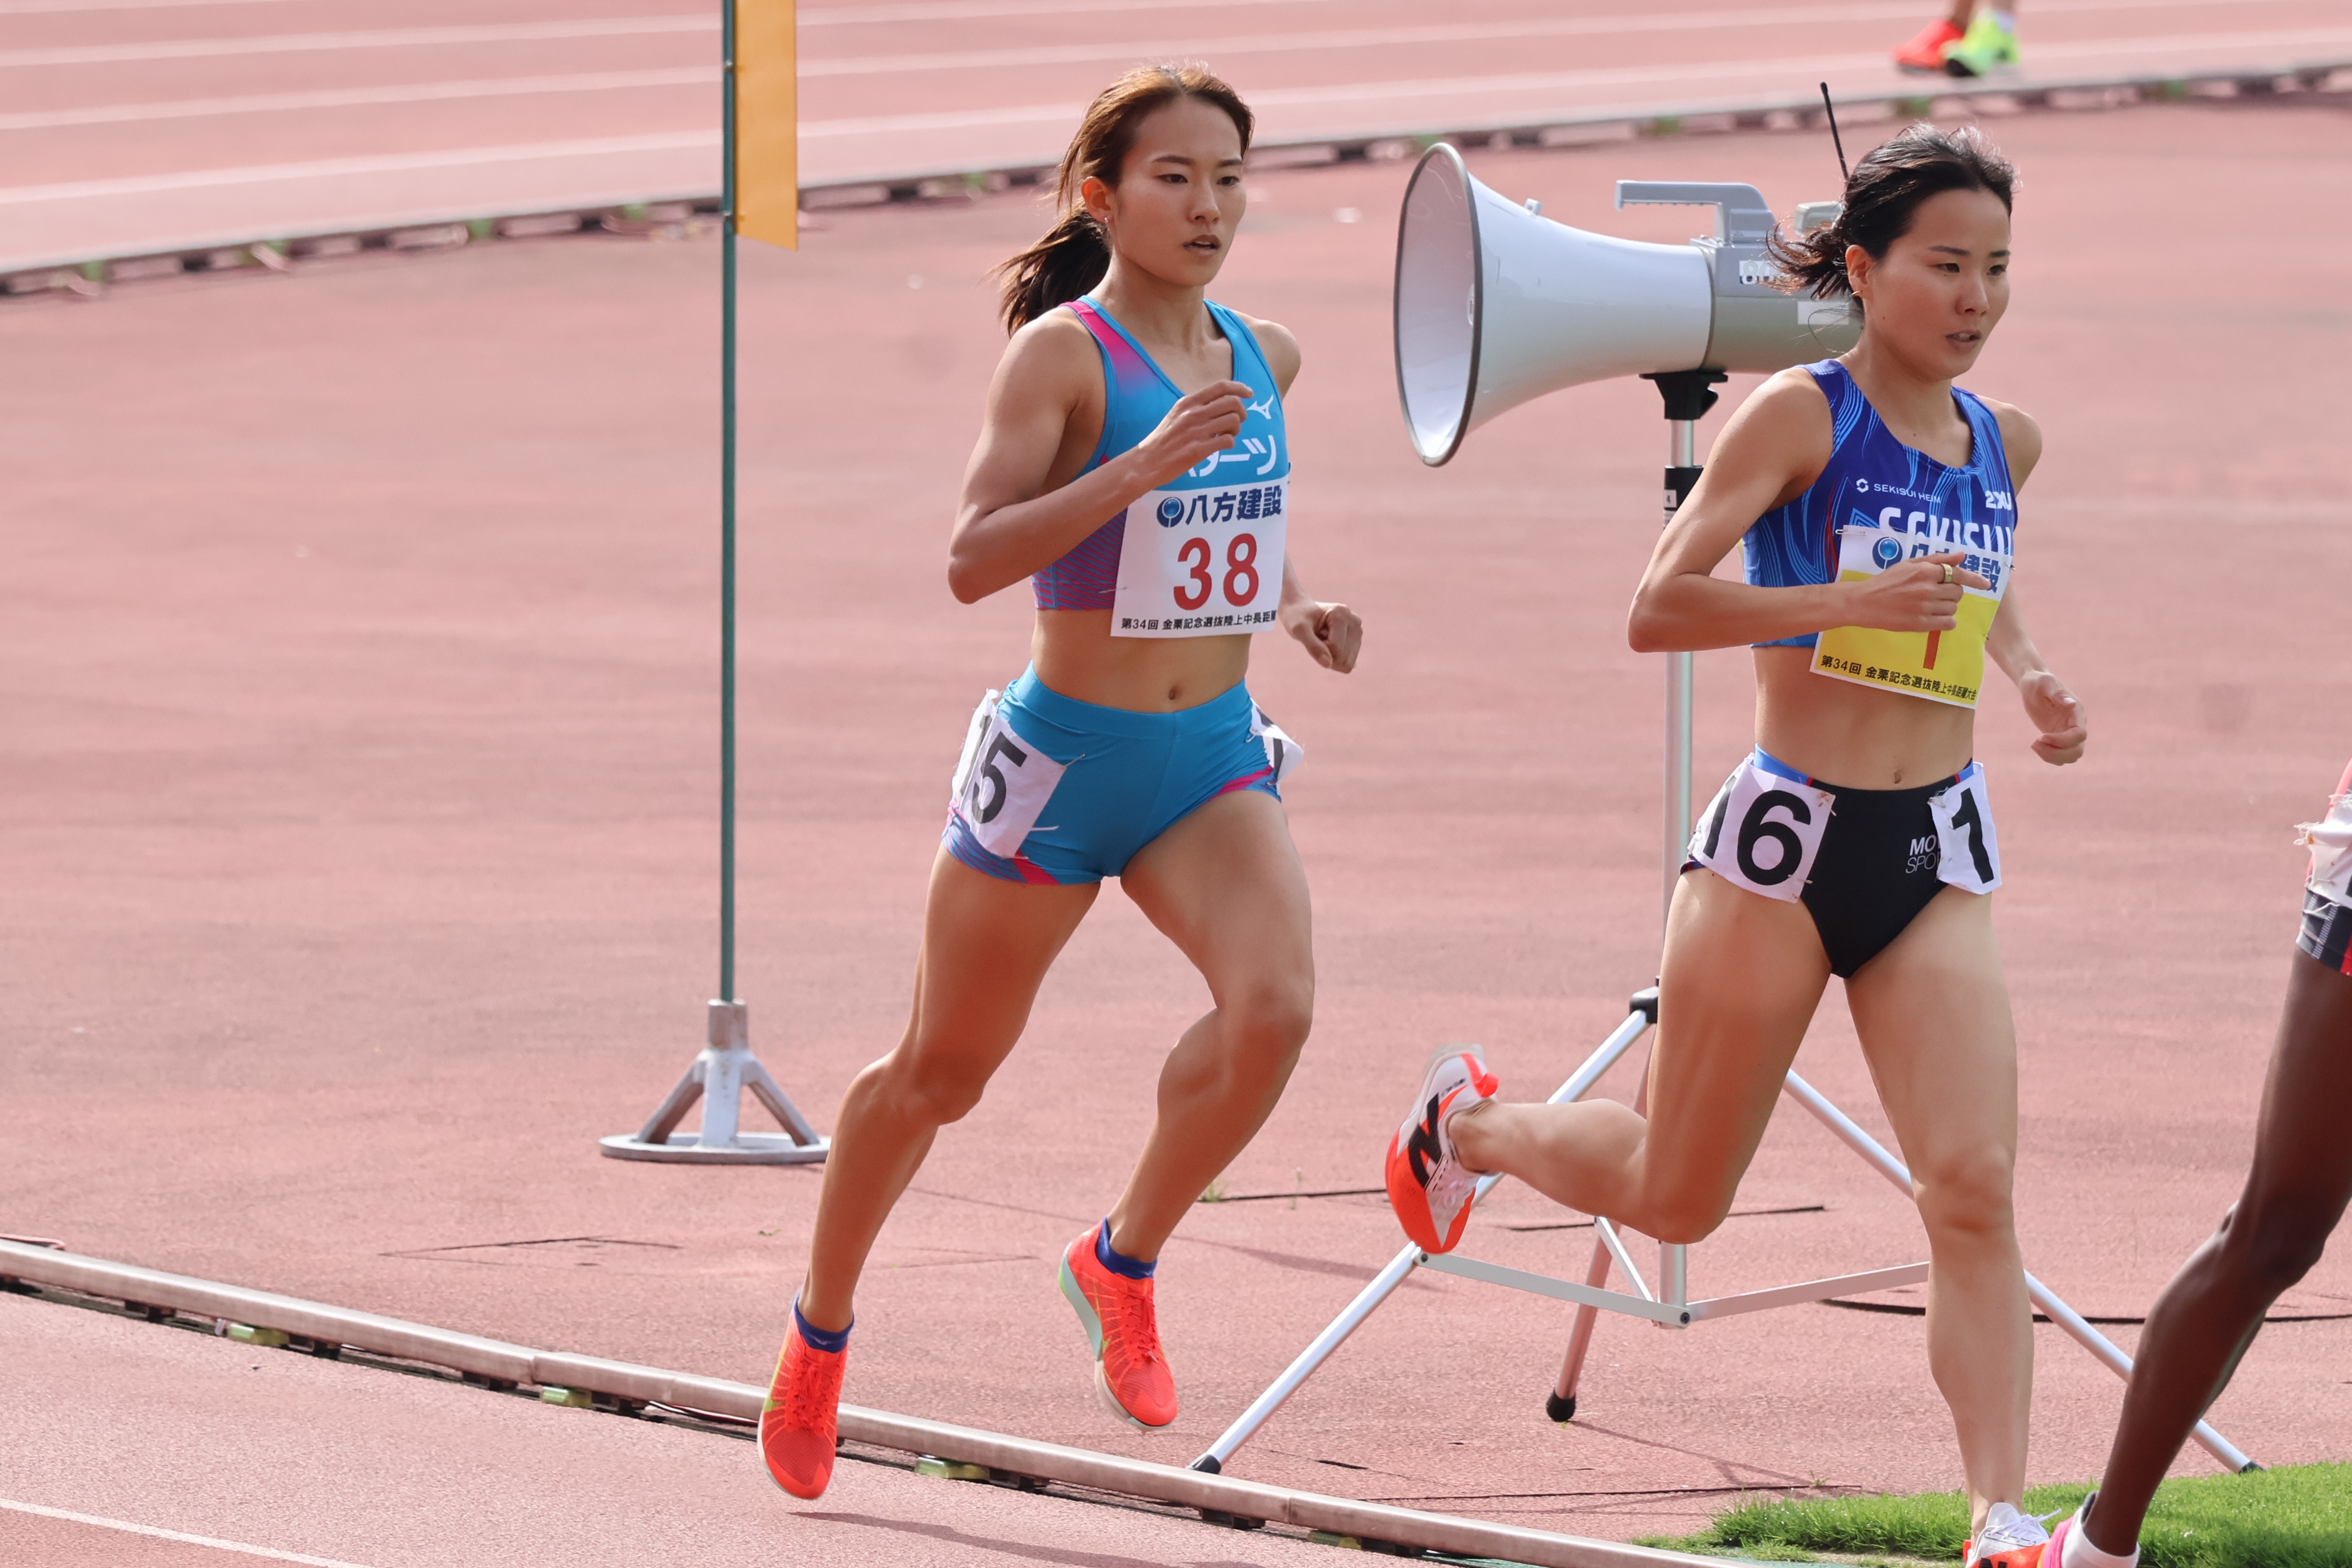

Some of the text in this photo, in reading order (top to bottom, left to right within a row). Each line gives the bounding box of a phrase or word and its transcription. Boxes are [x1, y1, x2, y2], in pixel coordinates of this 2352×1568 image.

[1874, 483, 1941, 503] SEKISUI HEIM
[1985, 490, 2012, 510] 2XU
[1185, 485, 1282, 525] 八方建設
[1173, 533, 1259, 611] 38
[1121, 618, 1158, 630] 第34回
[1821, 655, 1861, 675] 第34回
[1909, 835, 1940, 856] MO
[1951, 788, 1994, 884] 1
